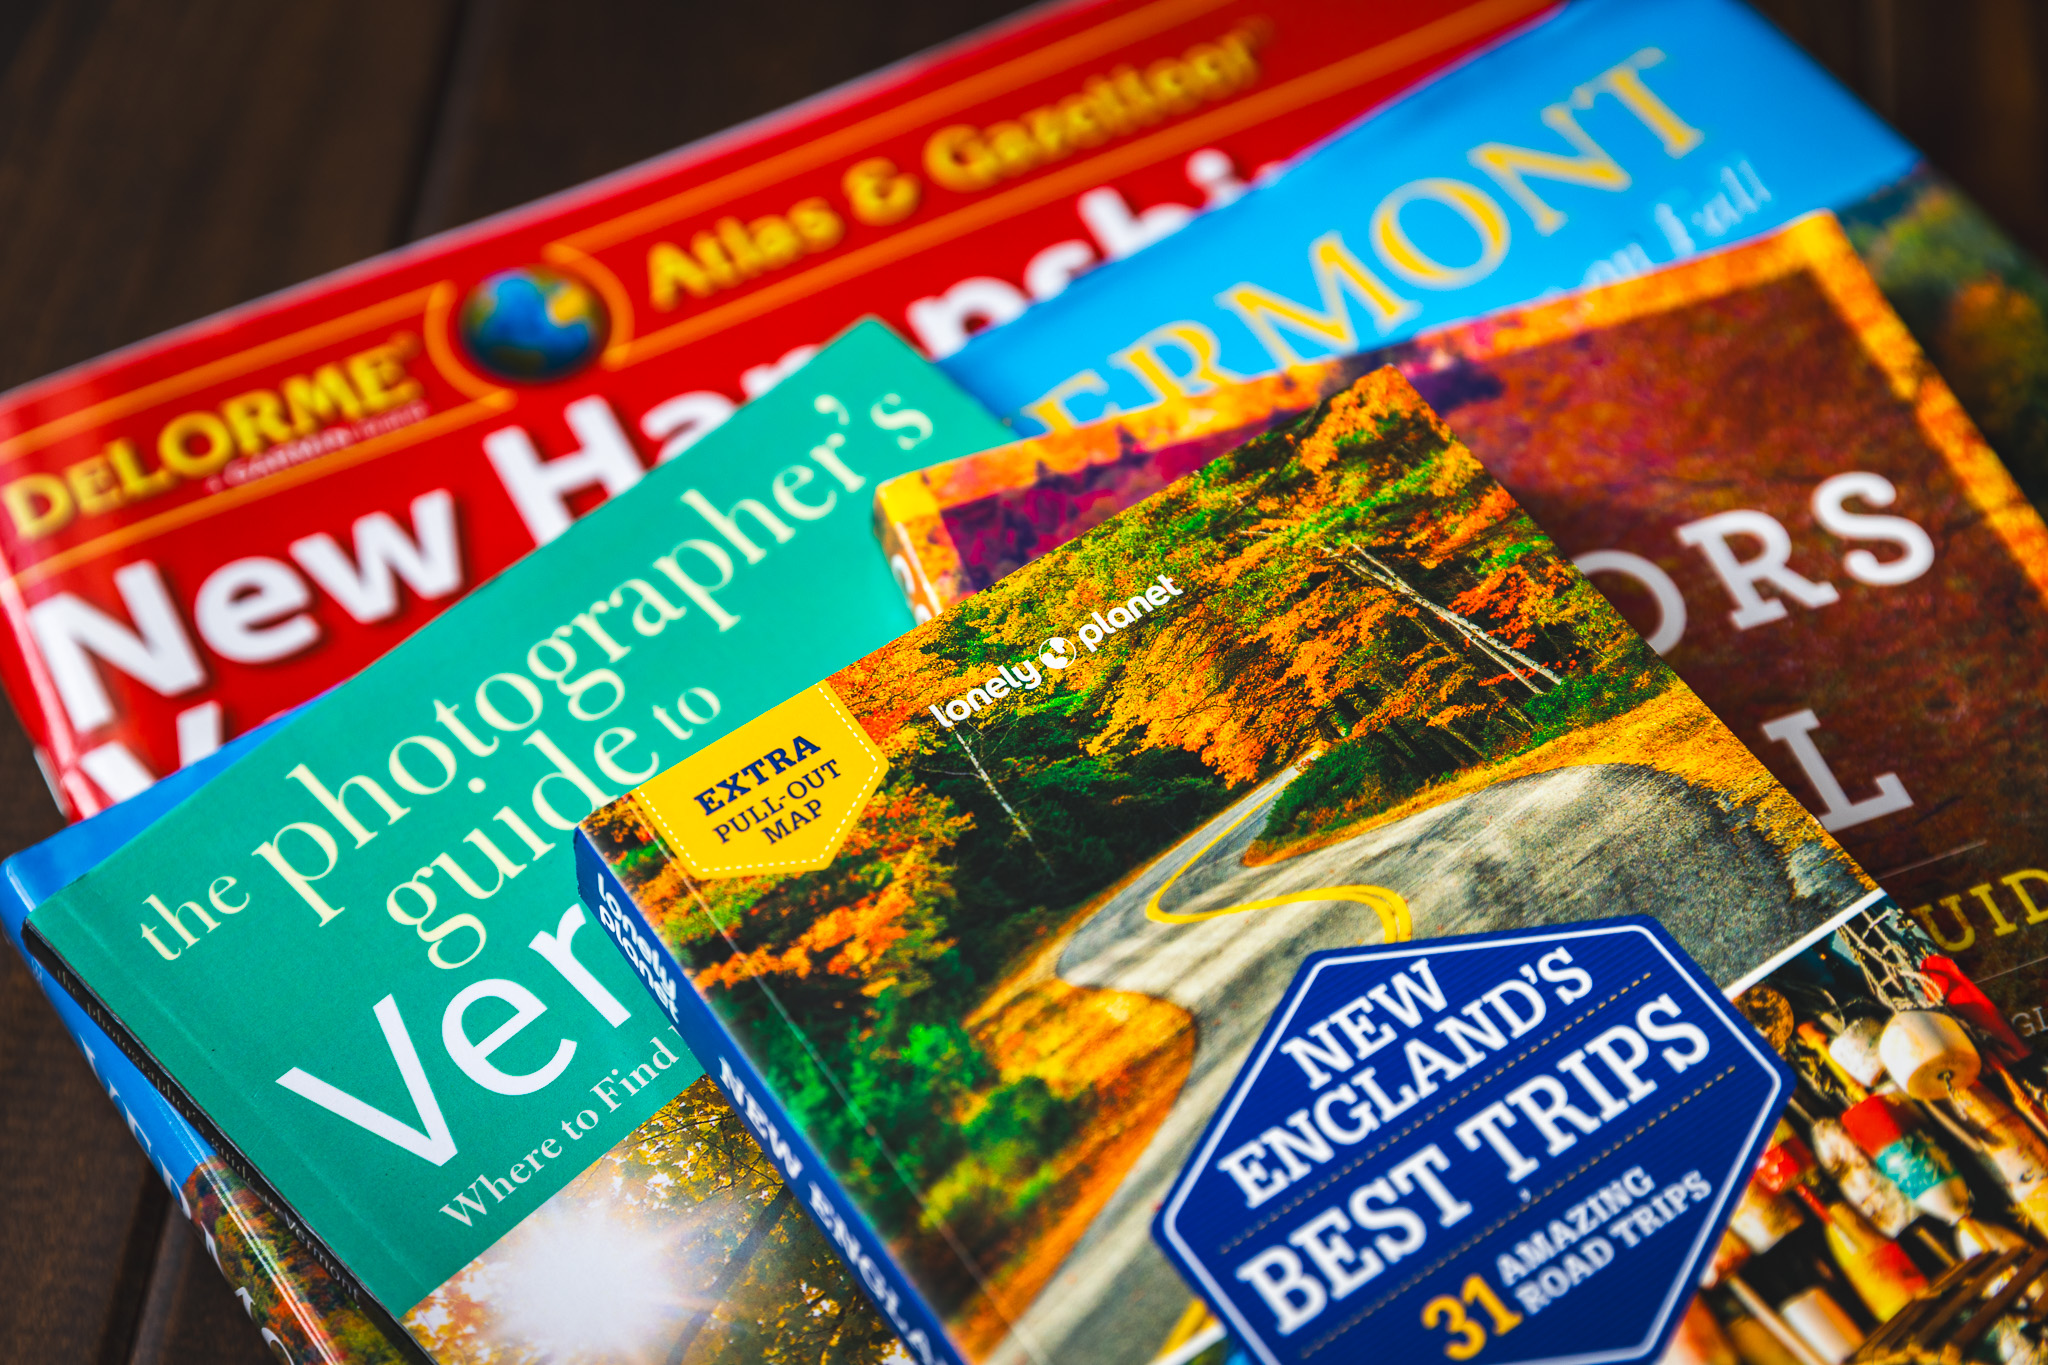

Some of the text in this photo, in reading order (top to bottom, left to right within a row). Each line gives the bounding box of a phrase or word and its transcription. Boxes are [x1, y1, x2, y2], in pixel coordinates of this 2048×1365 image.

[646, 196, 846, 313] Atlas
[840, 154, 923, 228] &
[28, 487, 466, 736] New
[140, 391, 933, 963] the photographer's
[928, 572, 1184, 730] lonely planet
[386, 726, 660, 970] guide
[652, 686, 722, 741] to
[692, 735, 822, 818] EXTRA
[711, 757, 844, 845] PULL-OUT
[760, 798, 825, 848] MAP
[597, 872, 677, 1001] lonely
[599, 904, 680, 1025] planet
[1216, 945, 1595, 1210] ENGLAND'S
[1280, 957, 1451, 1091] NEW
[438, 1036, 680, 1228] Where to Find
[1236, 992, 1711, 1337] BEST TRIPS
[284, 1211, 362, 1309] Vermont
[717, 1055, 948, 1365] NEW ENGLA
[1496, 1164, 1656, 1287] AMAZING
[1513, 1168, 1713, 1317] ROAD TRIPS
[1422, 1274, 1523, 1361] 31
